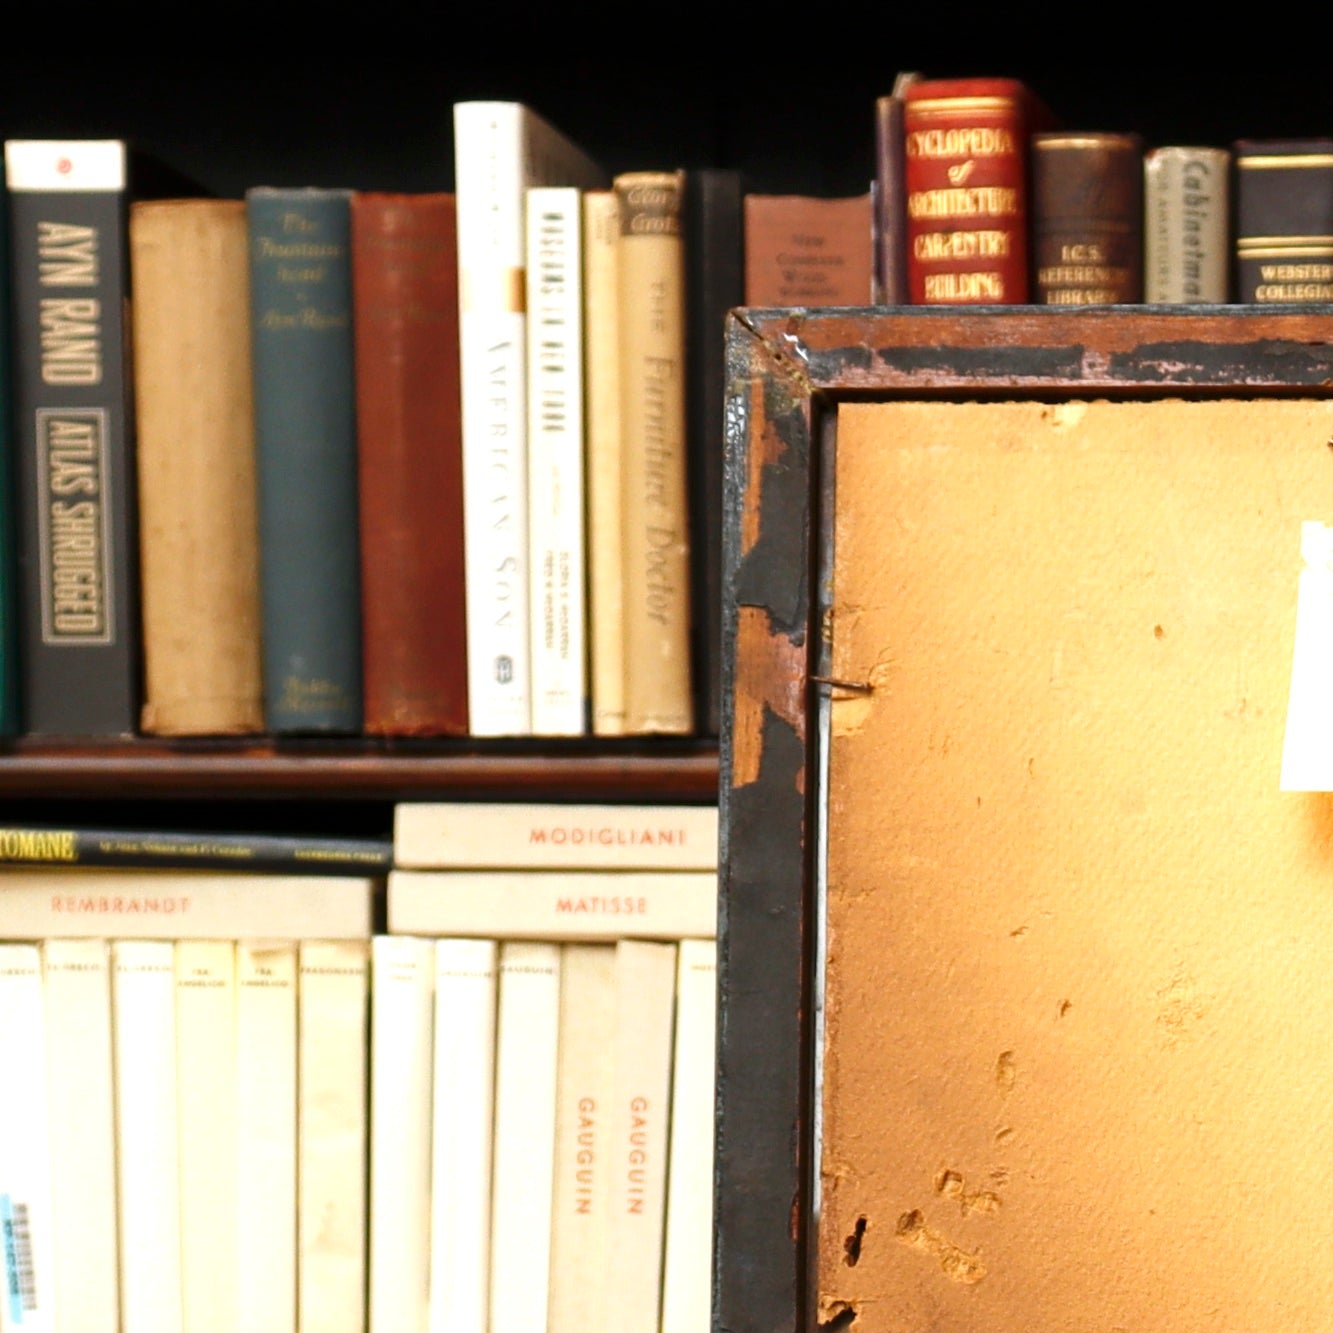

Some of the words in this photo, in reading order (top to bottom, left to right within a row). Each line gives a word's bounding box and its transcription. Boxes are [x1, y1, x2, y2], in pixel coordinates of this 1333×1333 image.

[906, 128, 1013, 156] CYCLOPEDIA
[37, 220, 100, 287] AYN
[914, 231, 1010, 260] CARPENTRY
[1183, 161, 1210, 305] Cabinetma
[924, 273, 1004, 300] BUILDING
[40, 298, 101, 387] RAND
[48, 420, 99, 496] ATLAS
[644, 357, 678, 508] Furniture
[51, 500, 100, 635] SHRUGGED
[645, 523, 681, 627] Doctor
[529, 828, 687, 846] MODIGLIANI
[51, 894, 191, 913] REMBRANDT
[556, 897, 649, 914] MATISSE
[575, 1097, 597, 1216] GAUGUIN
[626, 1096, 650, 1216] GAUGUIN
